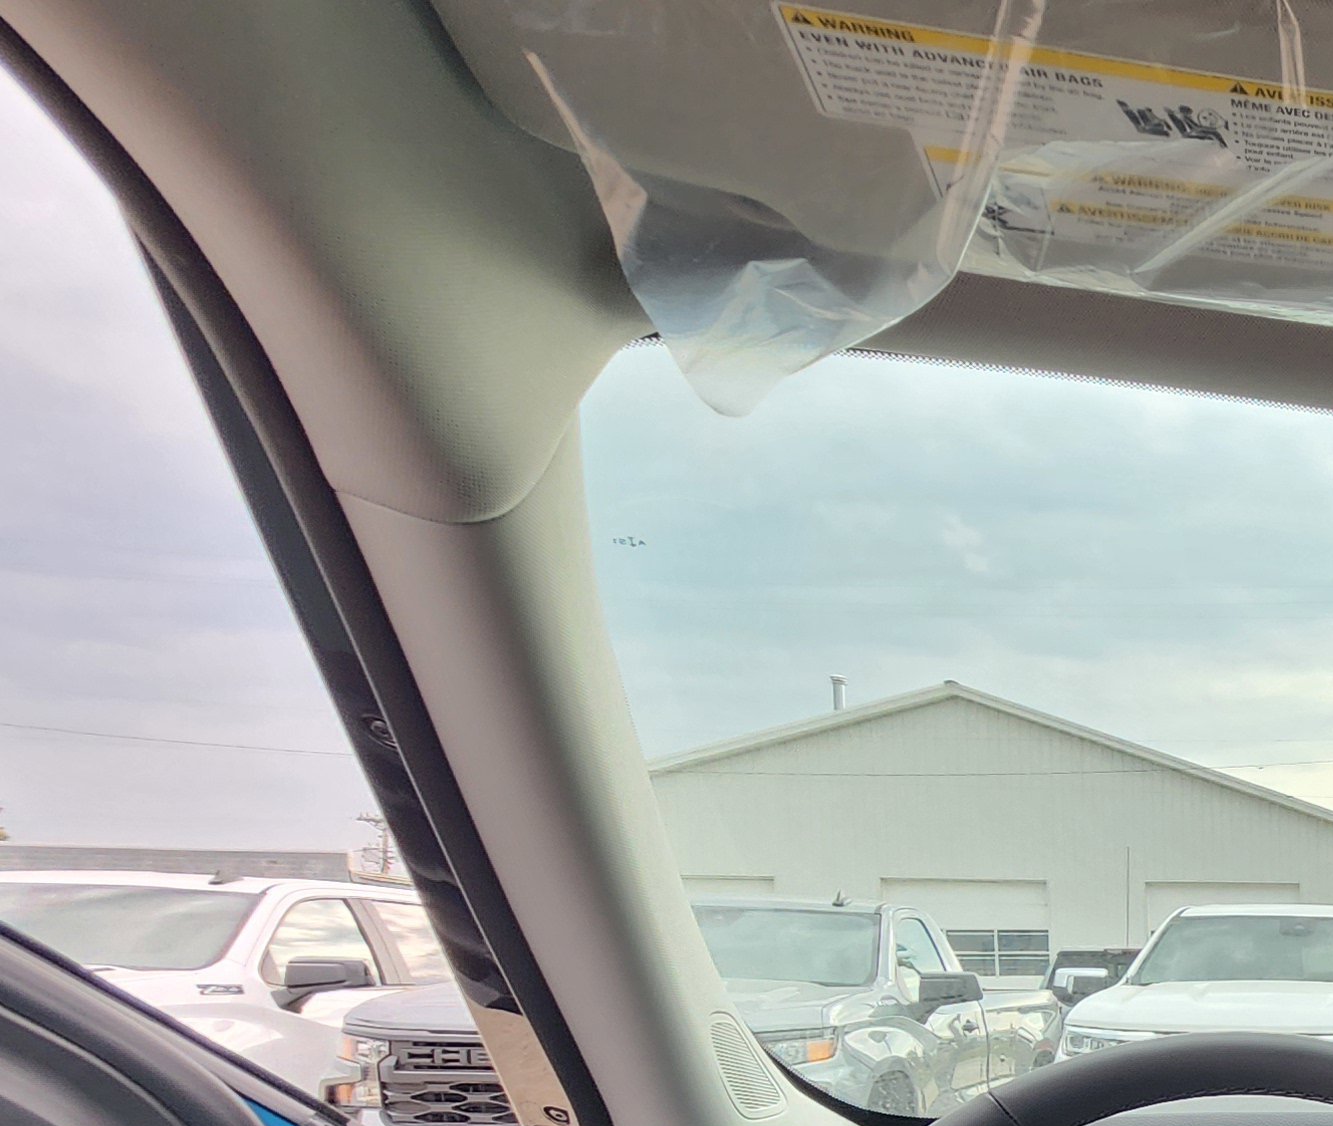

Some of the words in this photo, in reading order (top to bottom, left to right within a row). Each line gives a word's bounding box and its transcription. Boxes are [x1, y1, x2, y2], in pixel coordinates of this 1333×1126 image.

[817, 15, 916, 43] WARNING
[798, 30, 848, 47] EVEN
[854, 40, 905, 56] WITH
[1055, 71, 1104, 88] BAGS
[1276, 105, 1311, 119] AVEC
